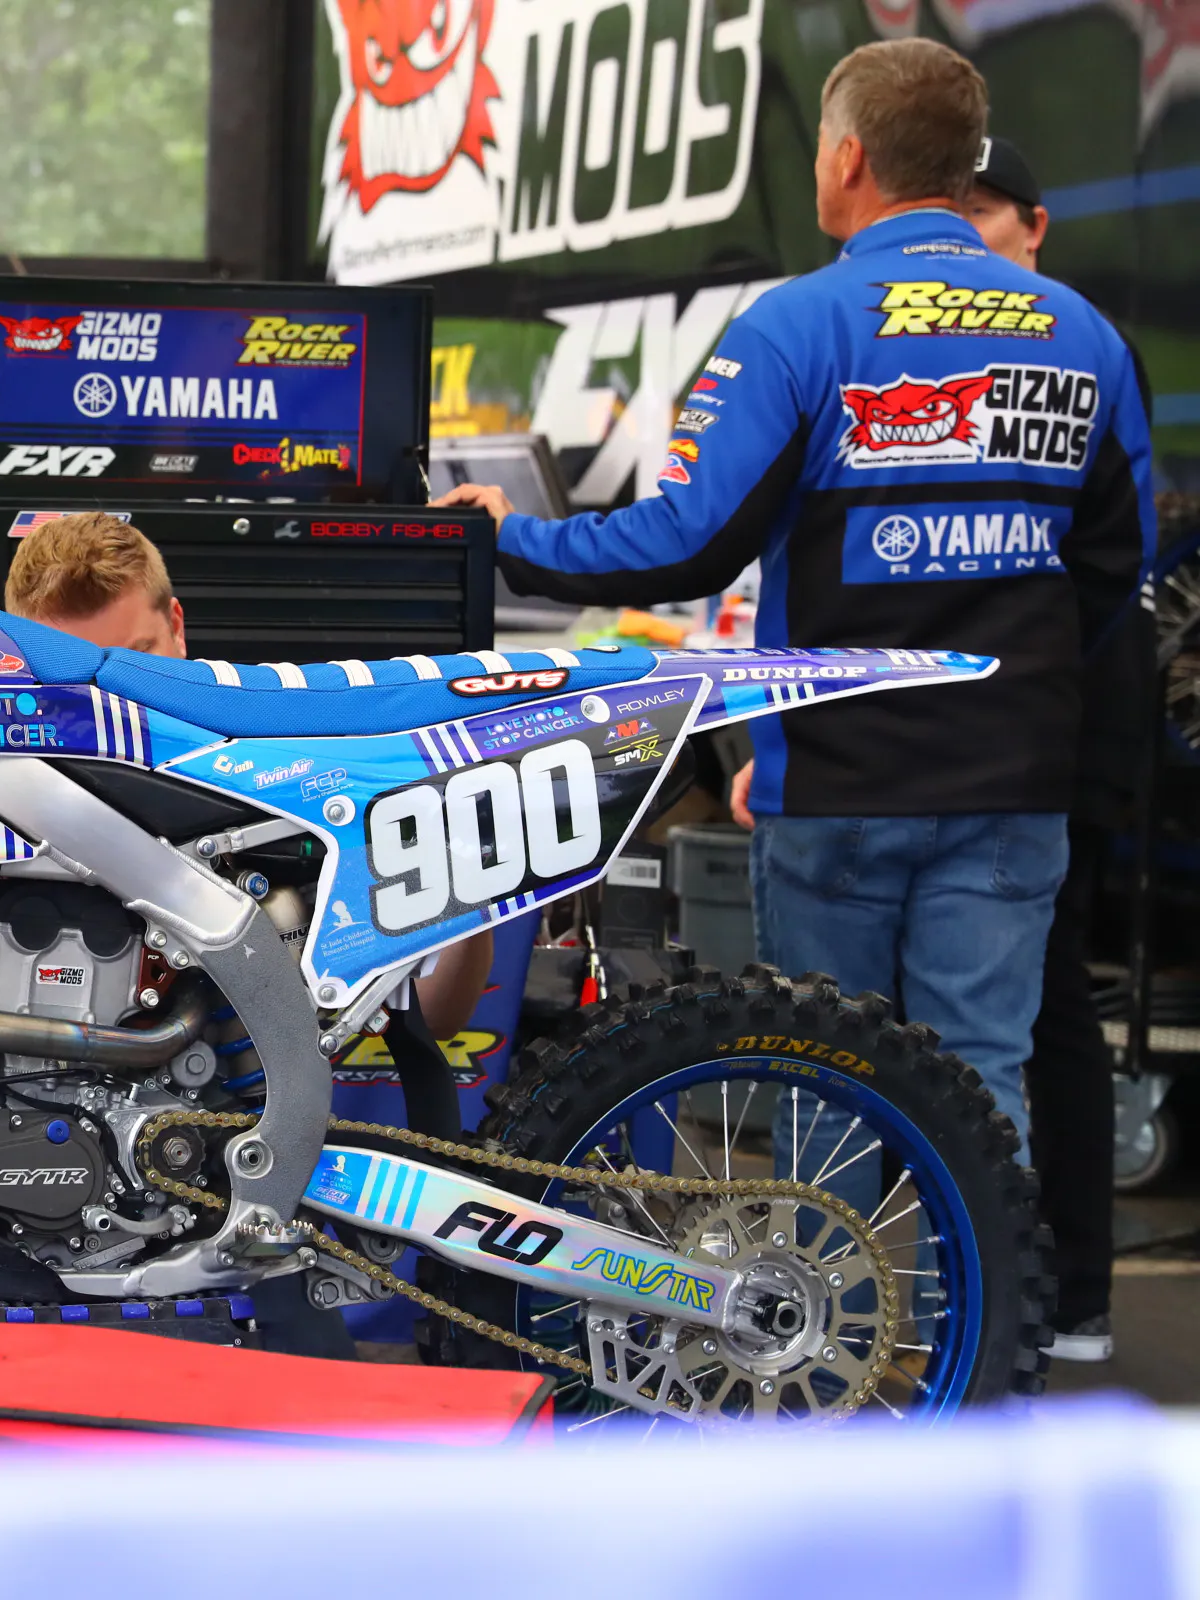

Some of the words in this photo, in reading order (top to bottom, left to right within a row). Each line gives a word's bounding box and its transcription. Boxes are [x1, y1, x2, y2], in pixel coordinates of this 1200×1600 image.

[509, 0, 747, 238] MODS
[880, 280, 1040, 311] ROCK
[75, 310, 163, 337] GIZMO
[244, 315, 351, 342] ROCK
[877, 306, 1055, 337] RIVER
[76, 336, 159, 362] MODS
[237, 339, 357, 364] RIVER
[120, 375, 279, 420] YAMAHA
[986, 367, 1098, 420] GIZMO
[294, 444, 338, 467] MATE
[986, 415, 1091, 467] MODS
[310, 521, 384, 537] BOBBY
[391, 522, 464, 538] FISHER
[890, 555, 1061, 576] RACING
[452, 671, 568, 694] GUTS
[722, 666, 867, 682] DUNLOP
[615, 687, 686, 715] ROWLEY
[483, 731, 521, 751] STOP
[522, 715, 584, 740] CANCER.
[485, 716, 524, 737] LOVE
[524, 706, 568, 727] MOTO.
[614, 738, 663, 767] SMX
[255, 767, 290, 789] Twin
[290, 759, 313, 777] Air
[300, 768, 348, 798] FCP
[369, 739, 603, 932] 900
[59, 967, 84, 976] GIZMO
[59, 976, 83, 985] MODS
[734, 1034, 876, 1077] DUNLOP
[767, 1060, 820, 1079] EXCEL
[432, 1200, 565, 1266] FLO
[570, 1246, 717, 1313] SUNSTAR
